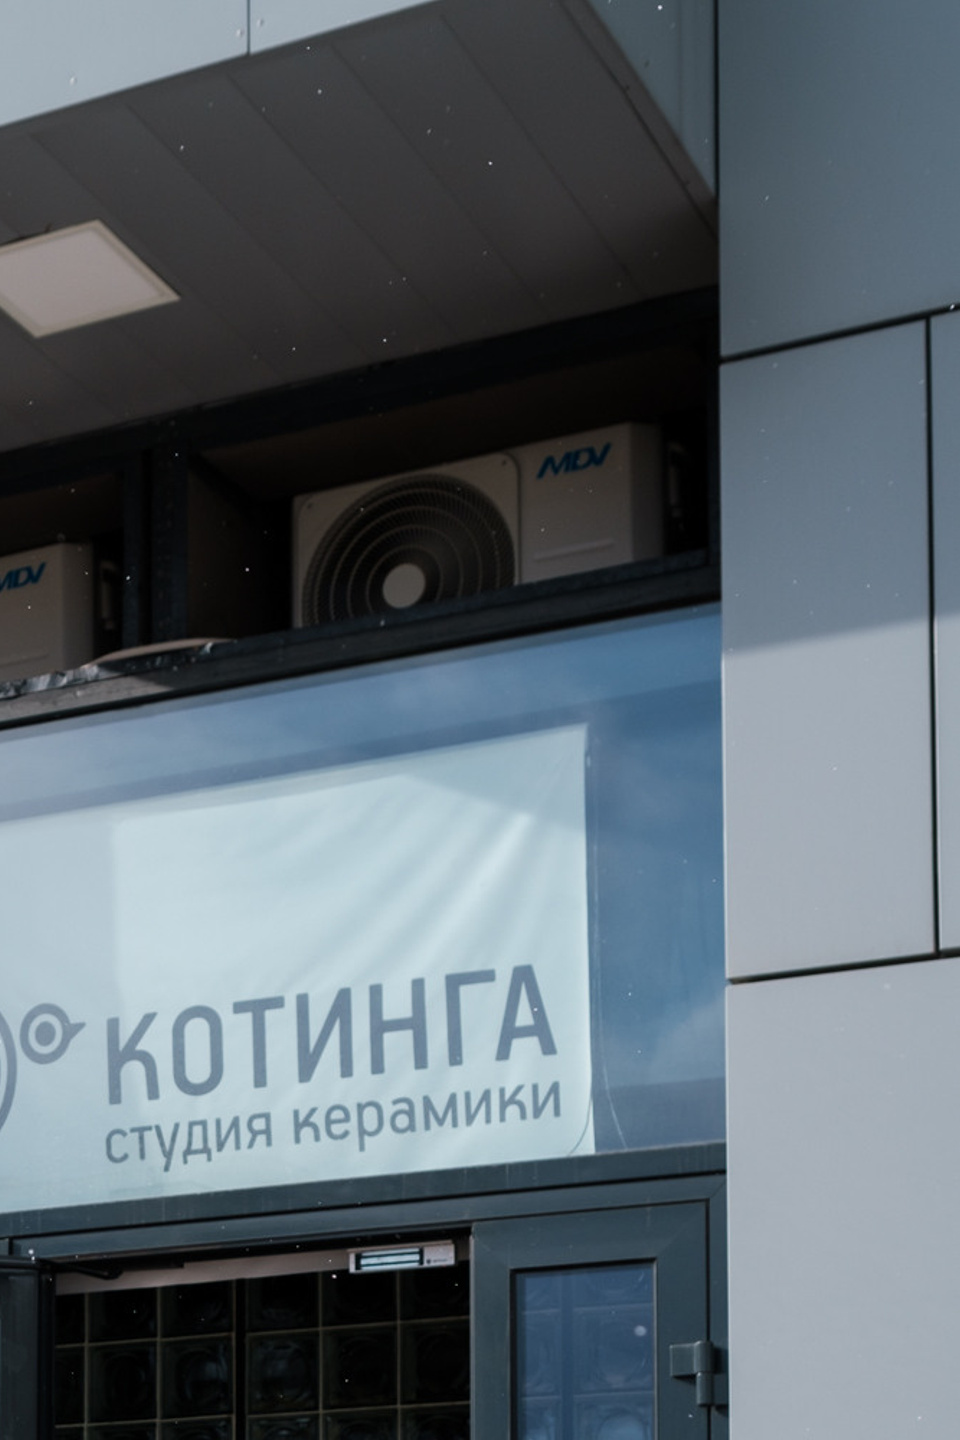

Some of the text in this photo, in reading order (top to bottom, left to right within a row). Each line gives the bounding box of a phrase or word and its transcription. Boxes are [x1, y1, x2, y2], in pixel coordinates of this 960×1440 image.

[536, 441, 612, 480] MDV
[105, 963, 558, 1106] КОТИНГА
[104, 1080, 564, 1172] студия керамики
